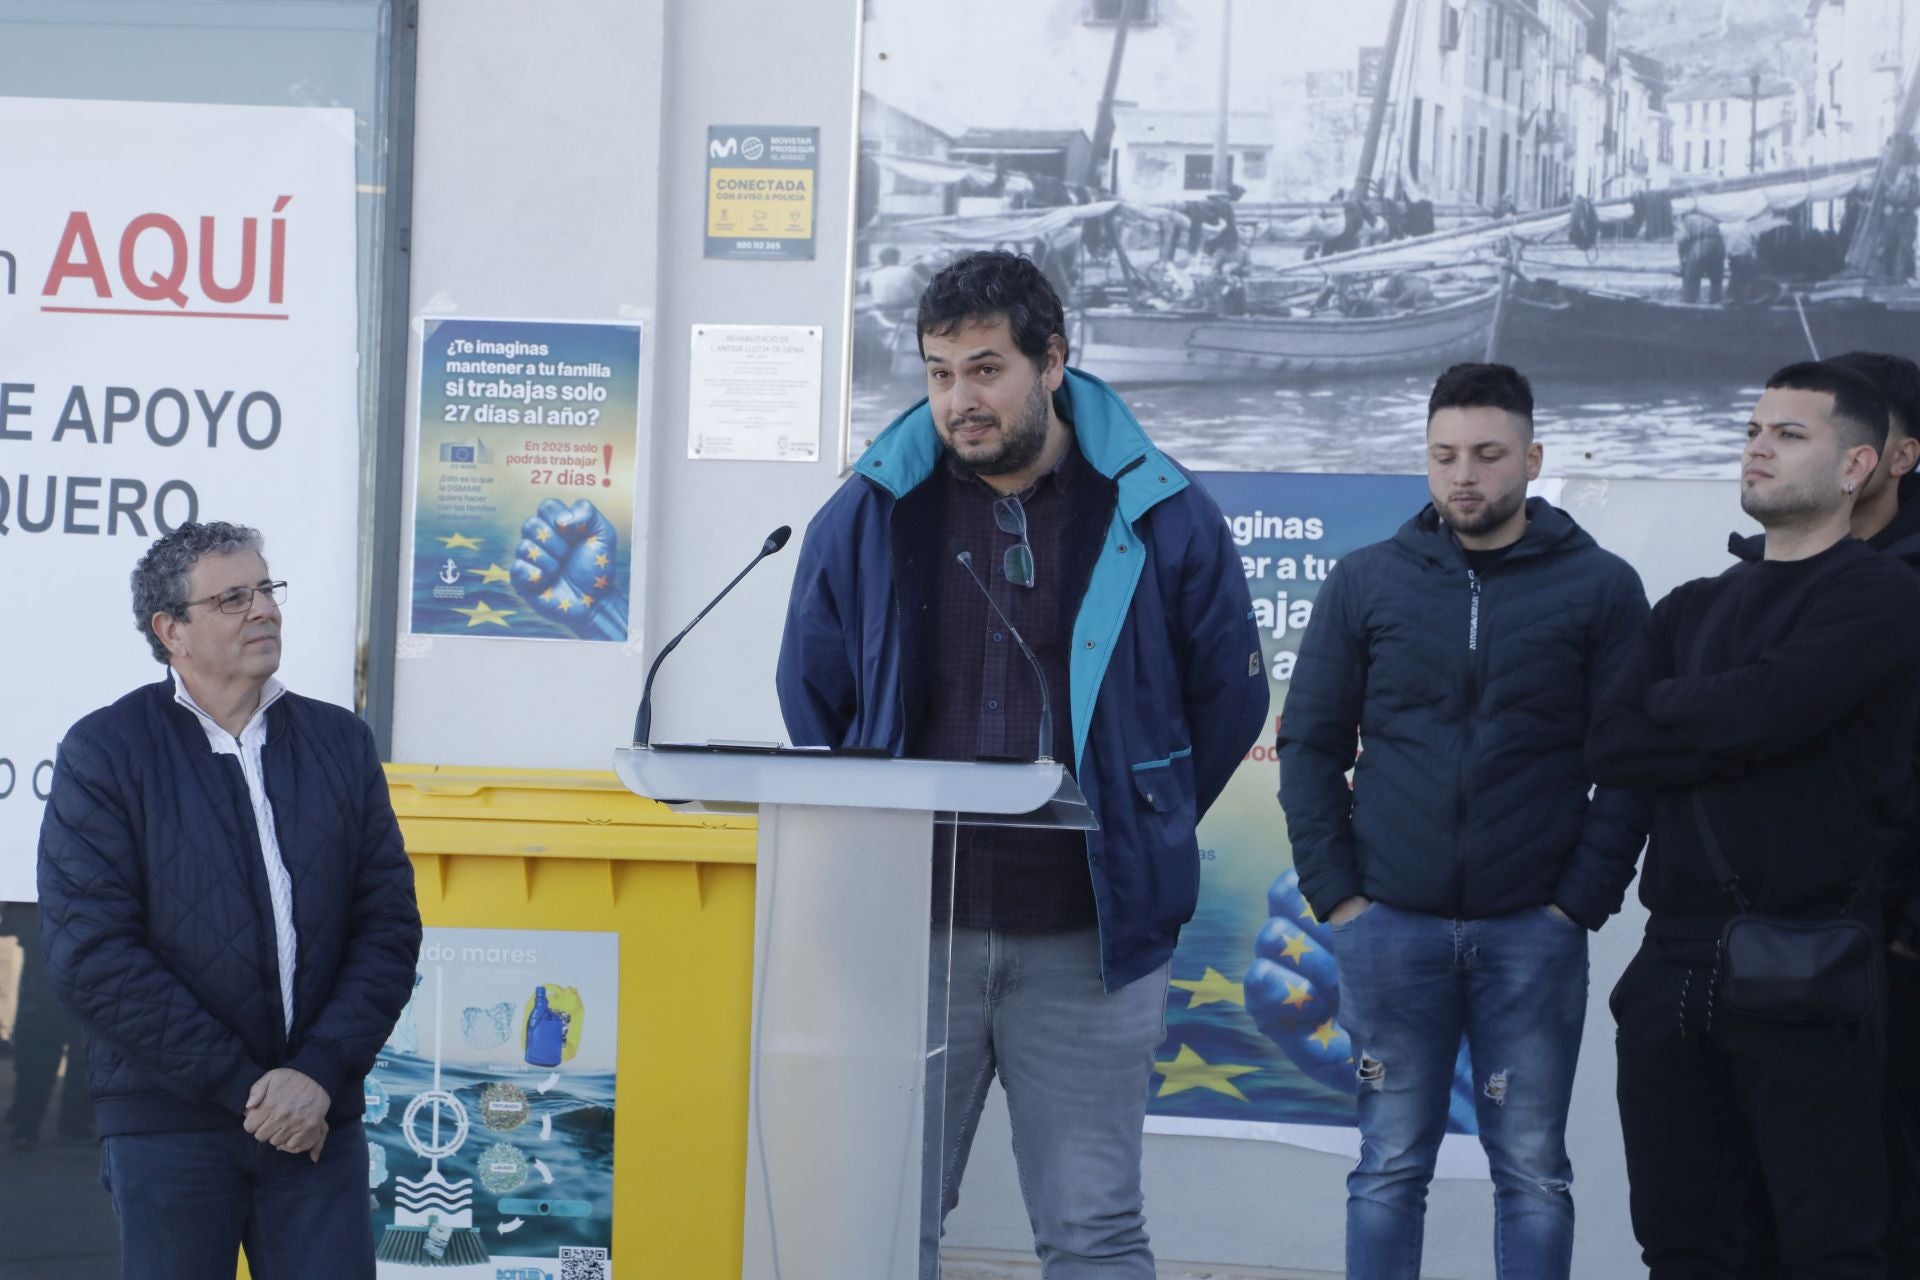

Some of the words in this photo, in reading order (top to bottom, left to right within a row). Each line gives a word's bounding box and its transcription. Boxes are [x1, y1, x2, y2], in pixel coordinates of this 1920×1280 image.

[770, 145, 815, 154] PROSEGUR
[716, 179, 806, 191] CONECTADA
[716, 192, 736, 200] CON
[737, 193, 762, 201] AVISO
[764, 193, 772, 201] A
[41, 195, 293, 309] AQUÍ
[447, 339, 473, 356] ¿Te
[475, 340, 549, 358] imaginas
[446, 361, 523, 375] mantener
[525, 364, 536, 376] a
[538, 363, 555, 376] tu
[557, 362, 611, 378] familia
[445, 378, 464, 397] si
[467, 379, 558, 403] trabajas
[561, 382, 607, 402] solo
[51, 384, 282, 451] APOYO
[444, 404, 470, 422] 27
[474, 404, 520, 424] días
[523, 406, 543, 425] al
[546, 406, 600, 426] año?
[524, 441, 540, 451] En
[541, 441, 572, 453] 2025
[573, 442, 598, 453] solo
[506, 453, 548, 467] podrás
[549, 454, 598, 467] trabajar
[530, 470, 552, 484] 27
[556, 469, 597, 487] días
[1276, 557, 1297, 580] a
[462, 946, 537, 964] mares
